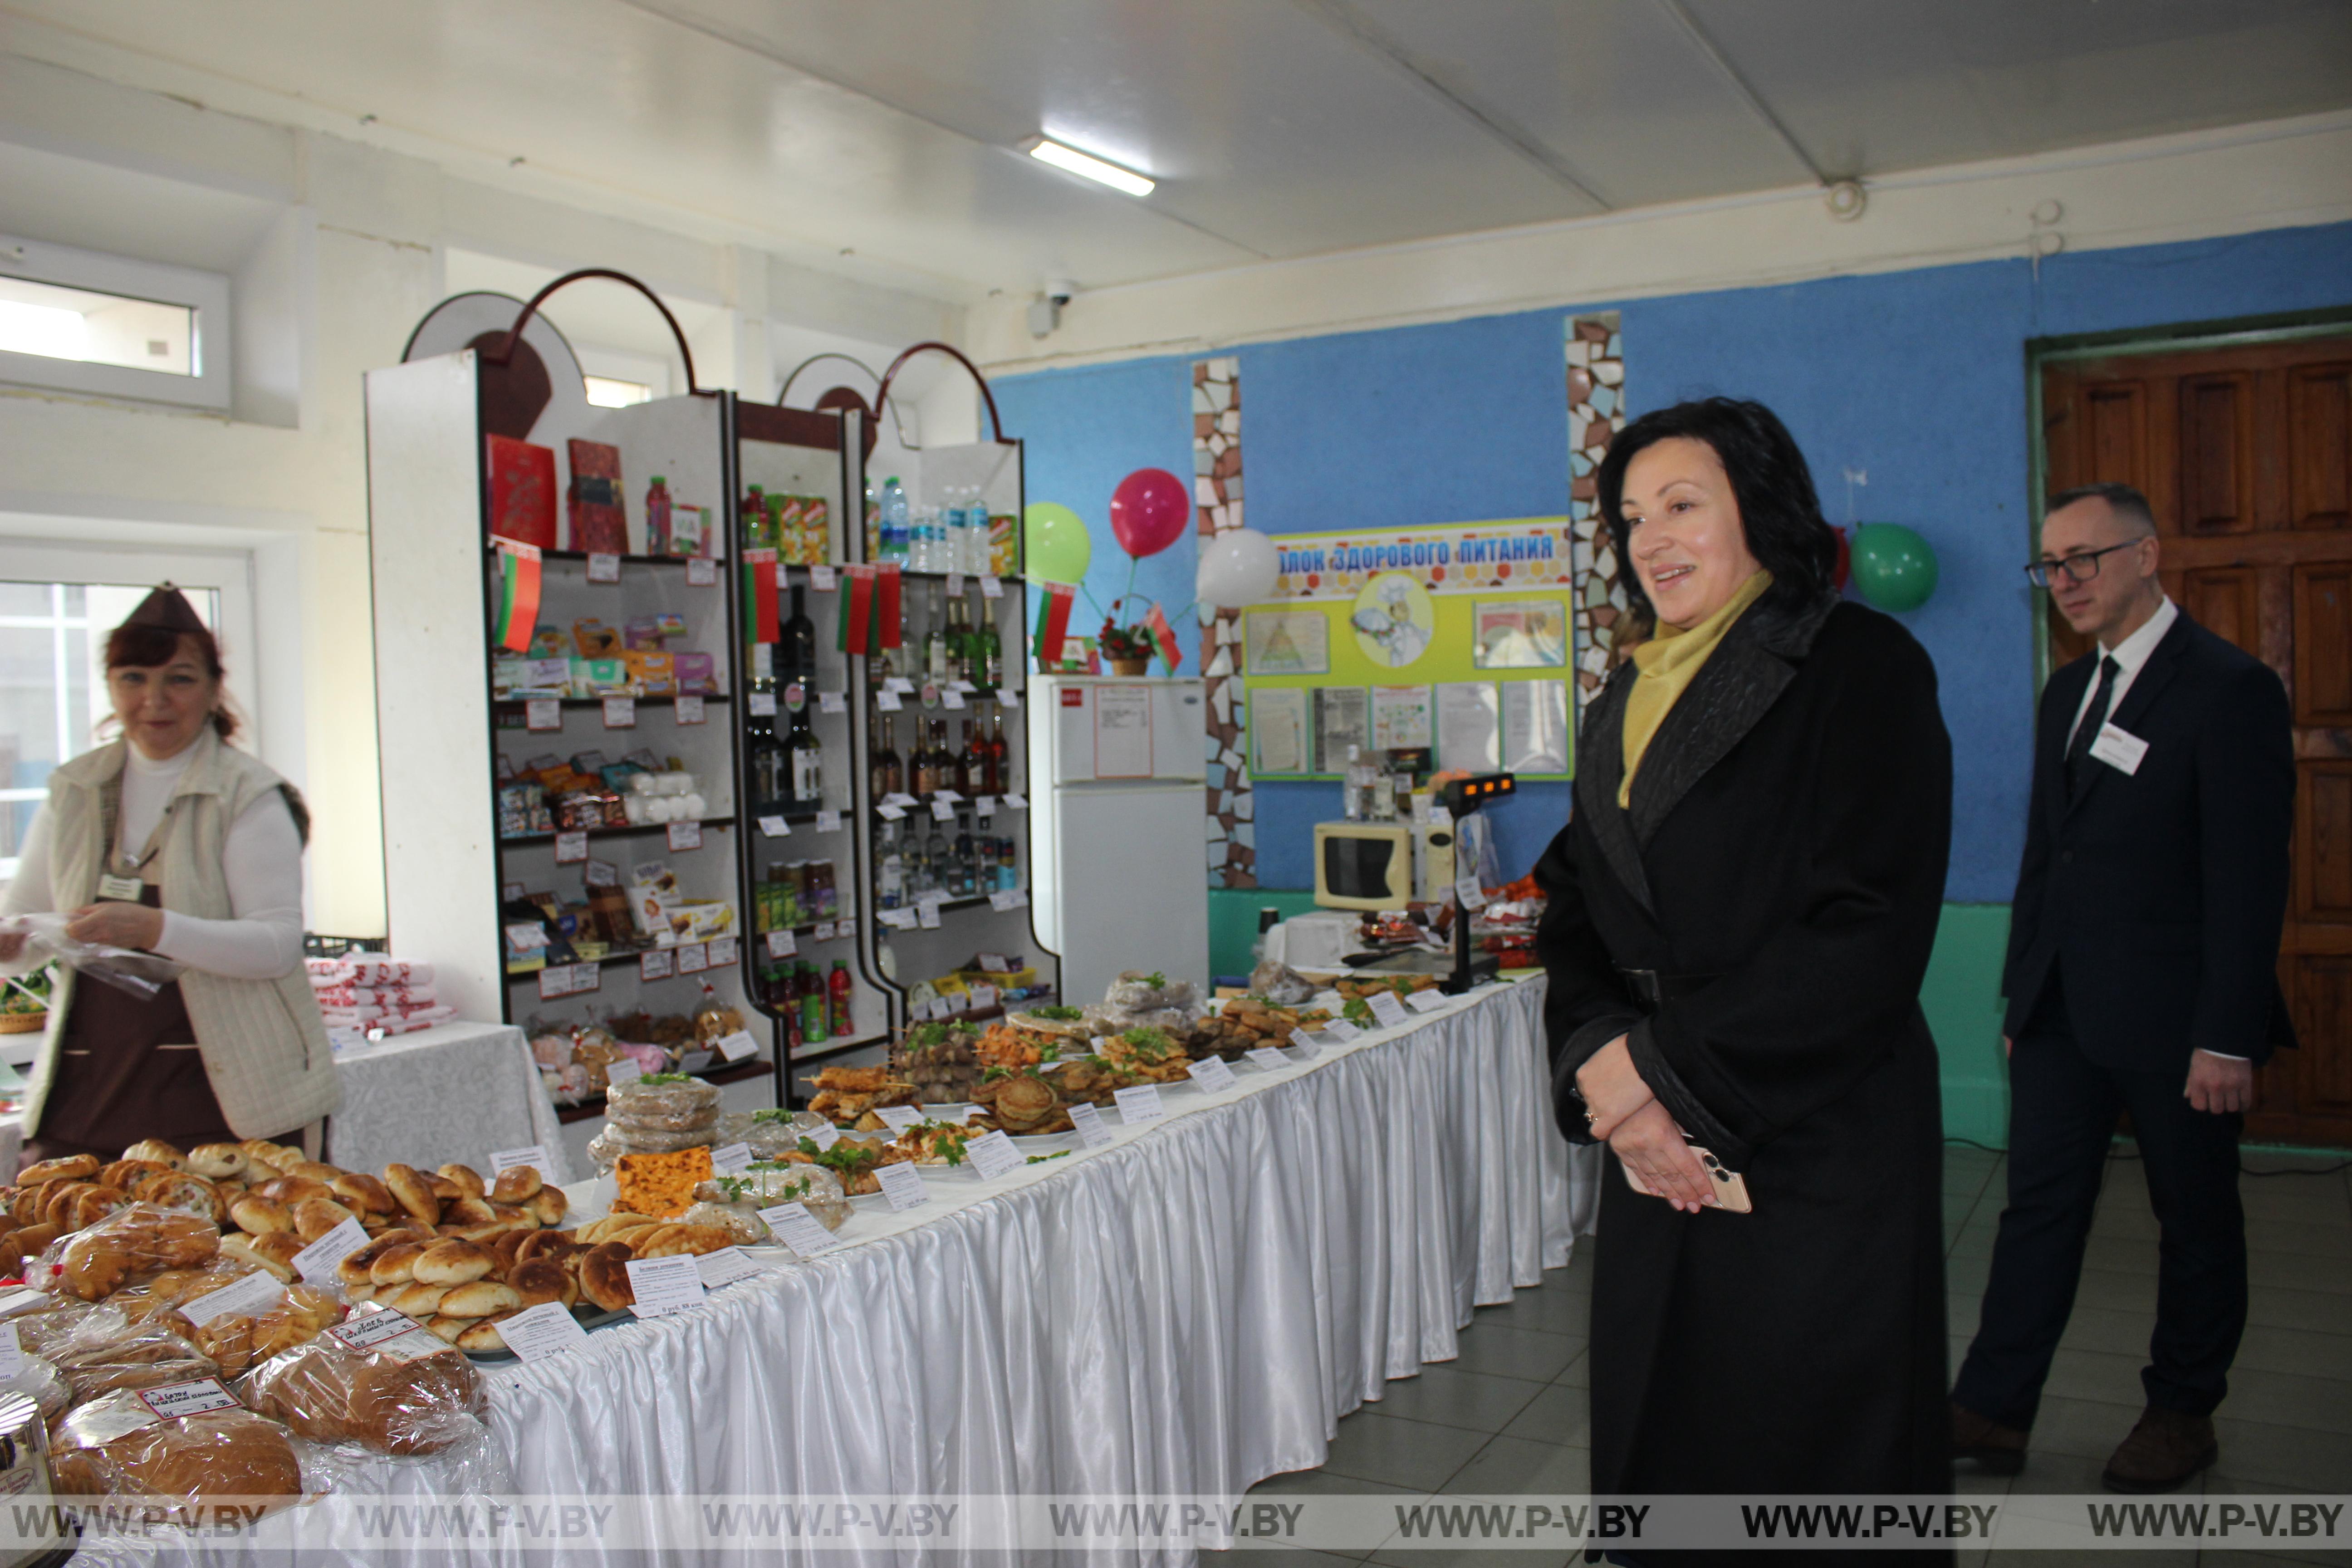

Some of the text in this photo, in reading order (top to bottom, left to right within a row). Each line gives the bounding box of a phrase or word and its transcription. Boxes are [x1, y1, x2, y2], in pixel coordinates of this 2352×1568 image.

[1333, 541, 1450, 573] ЗДОРОВОГО
[1460, 535, 1554, 564] ПИТАНИЯ
[667, 1304, 681, 1313] руб.
[165, 1391, 187, 1399] БАТОН
